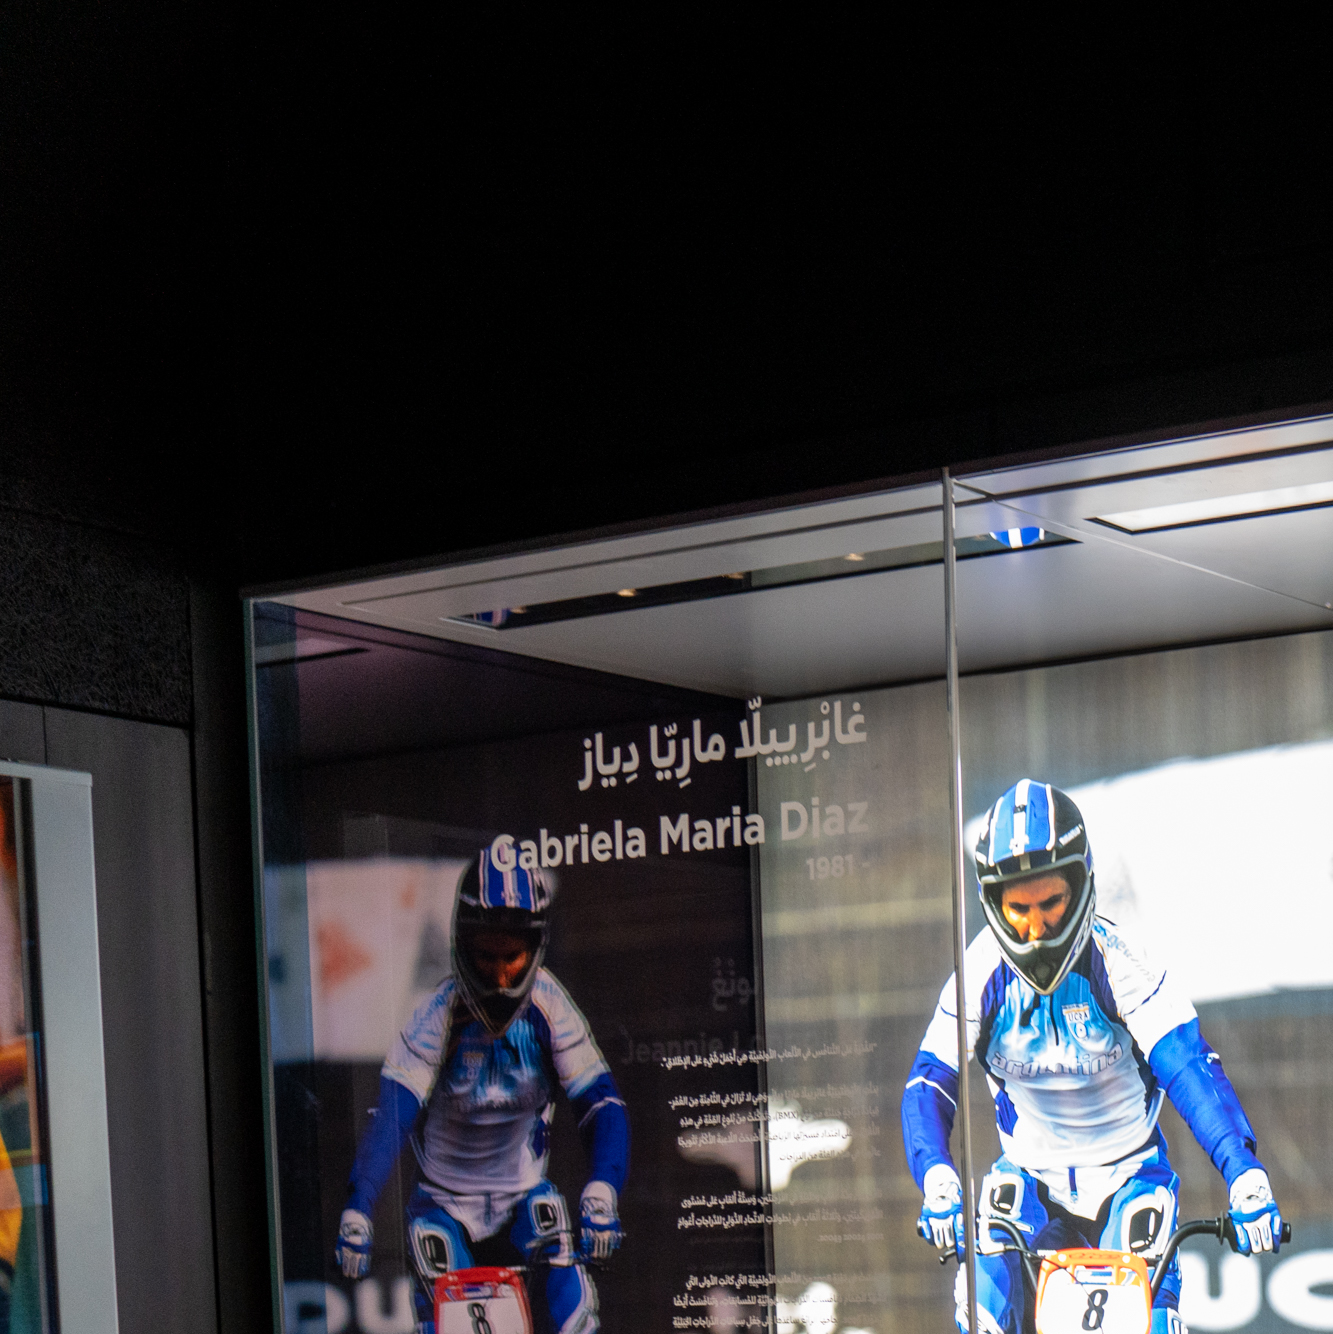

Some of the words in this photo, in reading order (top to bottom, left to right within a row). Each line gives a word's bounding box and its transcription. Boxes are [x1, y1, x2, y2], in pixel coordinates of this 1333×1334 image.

[490, 819, 647, 873] Gabriela
[659, 805, 766, 855] Maria
[780, 796, 869, 841] Diaz
[806, 854, 853, 881] 1981
[1082, 1289, 1108, 1331] 8
